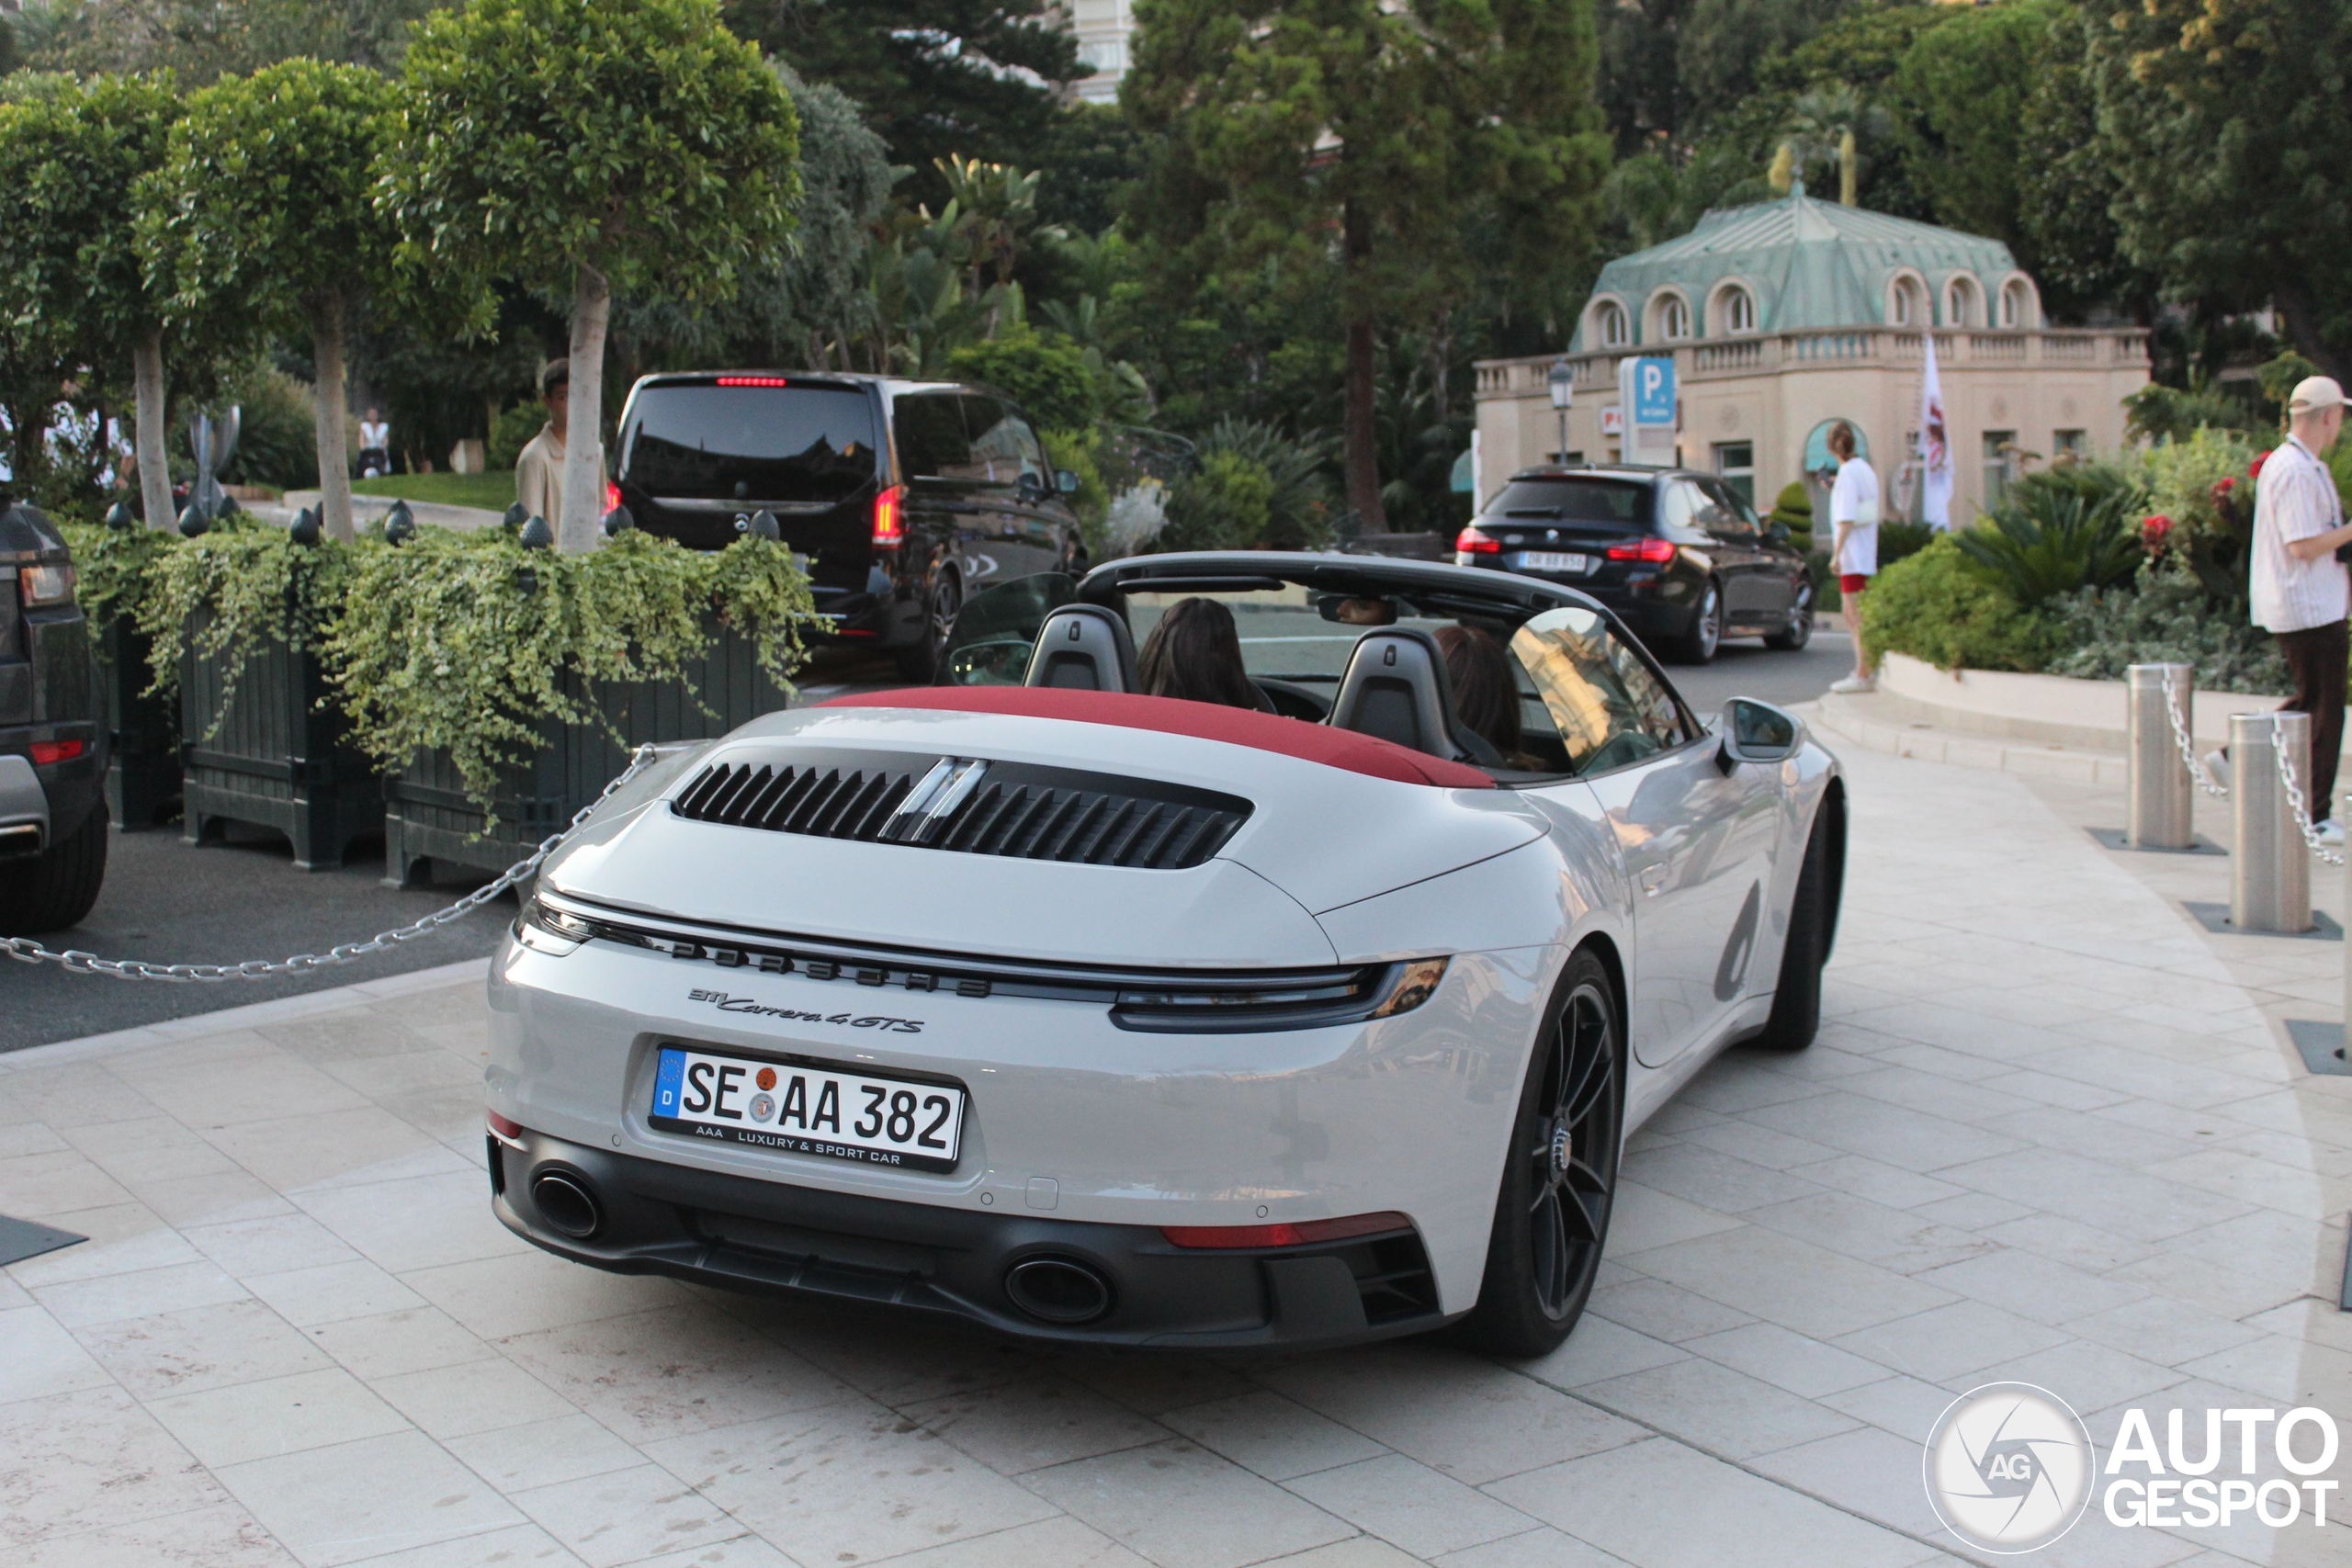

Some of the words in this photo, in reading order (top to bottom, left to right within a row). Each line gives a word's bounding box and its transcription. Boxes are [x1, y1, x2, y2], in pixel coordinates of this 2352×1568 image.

[1644, 364, 1662, 400] P
[672, 942, 991, 998] PORSCHE
[688, 987, 729, 1004] 911
[717, 998, 822, 1021] Carrera
[825, 1012, 852, 1024] 4
[851, 1016, 925, 1032] GTS
[662, 1090, 673, 1106] D
[684, 1063, 746, 1120] SE
[778, 1076, 840, 1134] AA
[854, 1085, 951, 1149] 382
[695, 1125, 724, 1138] AAA
[738, 1132, 796, 1150] LUXURY
[800, 1141, 809, 1151] &
[816, 1144, 865, 1160] SPORT
[870, 1152, 900, 1165] CAR
